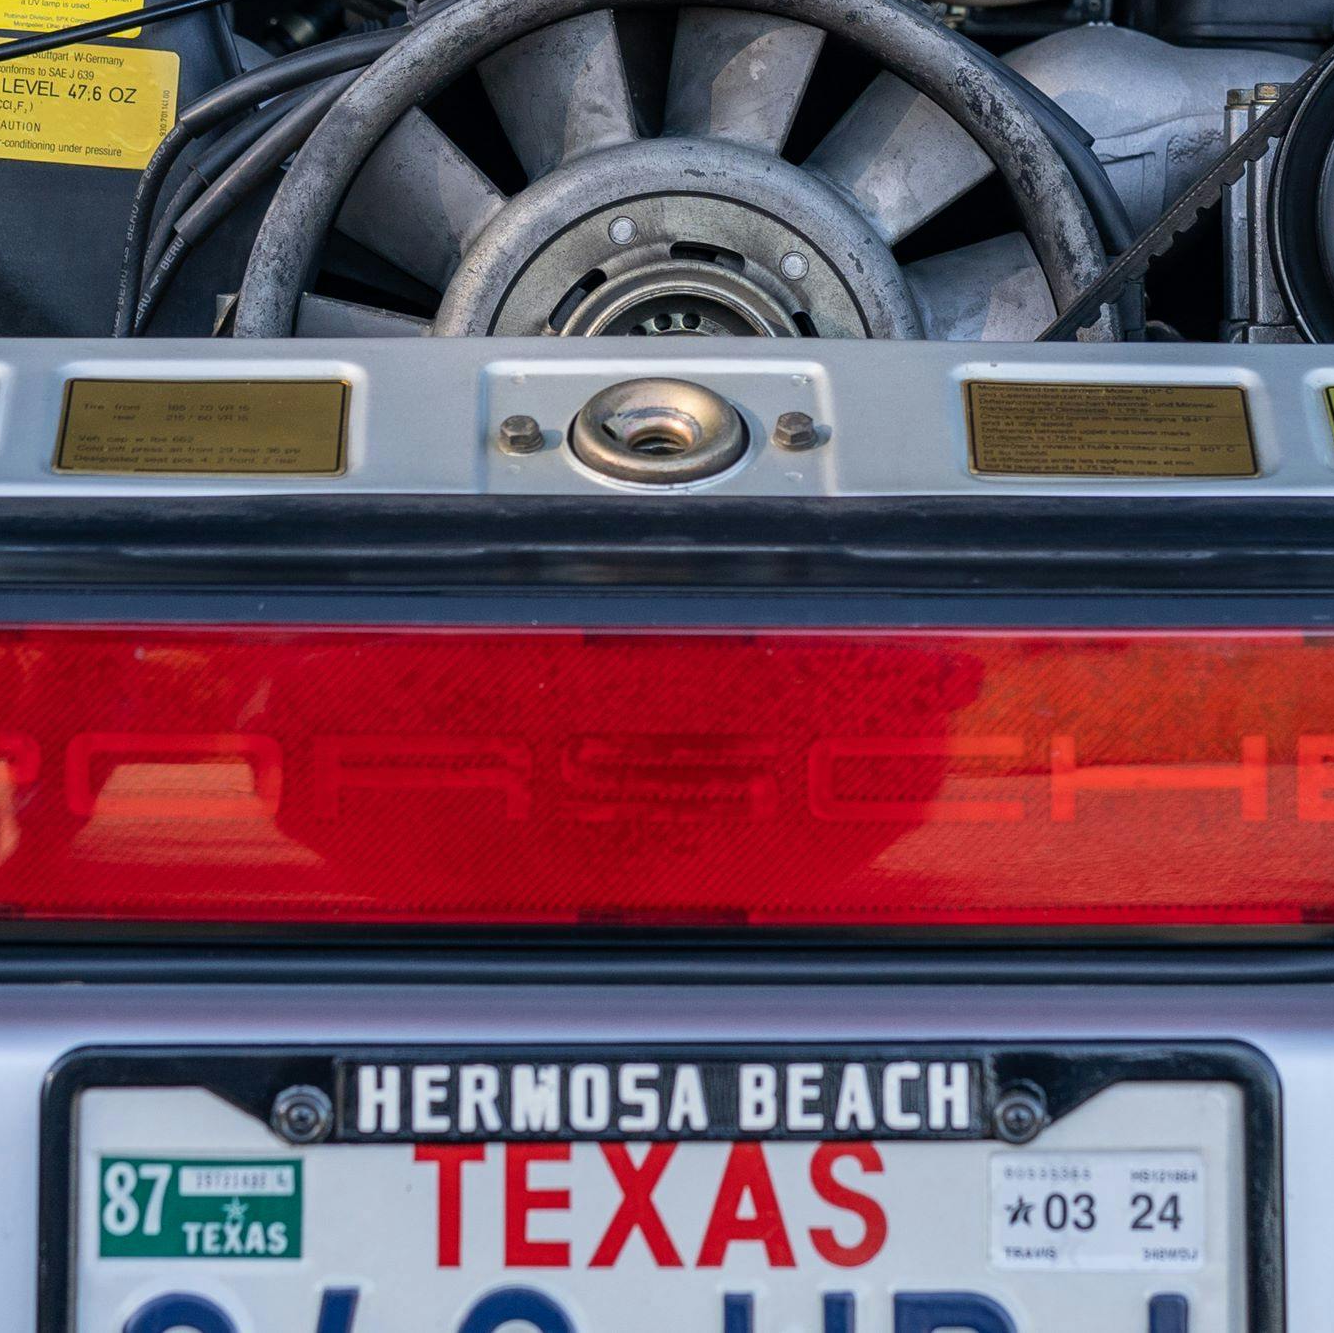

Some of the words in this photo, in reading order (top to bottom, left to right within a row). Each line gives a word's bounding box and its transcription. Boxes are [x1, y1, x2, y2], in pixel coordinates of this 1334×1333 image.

[41, 0, 61, 8] lamp
[38, 67, 47, 77] to
[48, 68, 67, 79] SAE
[77, 70, 95, 81] 639
[74, 52, 125, 67] W-Germany
[2, 77, 60, 98] LEVEL
[109, 86, 138, 104] OZ
[58, 143, 83, 154] under
[85, 145, 122, 157] pressure
[144, 144, 167, 180] BERU
[127, 203, 140, 242] BERU
[160, 236, 185, 272] BERU
[357, 1062, 710, 1133] HERMOSA
[738, 1061, 971, 1132] BEACH
[102, 1161, 173, 1237] 87
[413, 1141, 888, 1269] TEXAS
[1043, 1192, 1097, 1232] 03
[1129, 1192, 1183, 1232] 24
[181, 1221, 288, 1255] TEXAS
